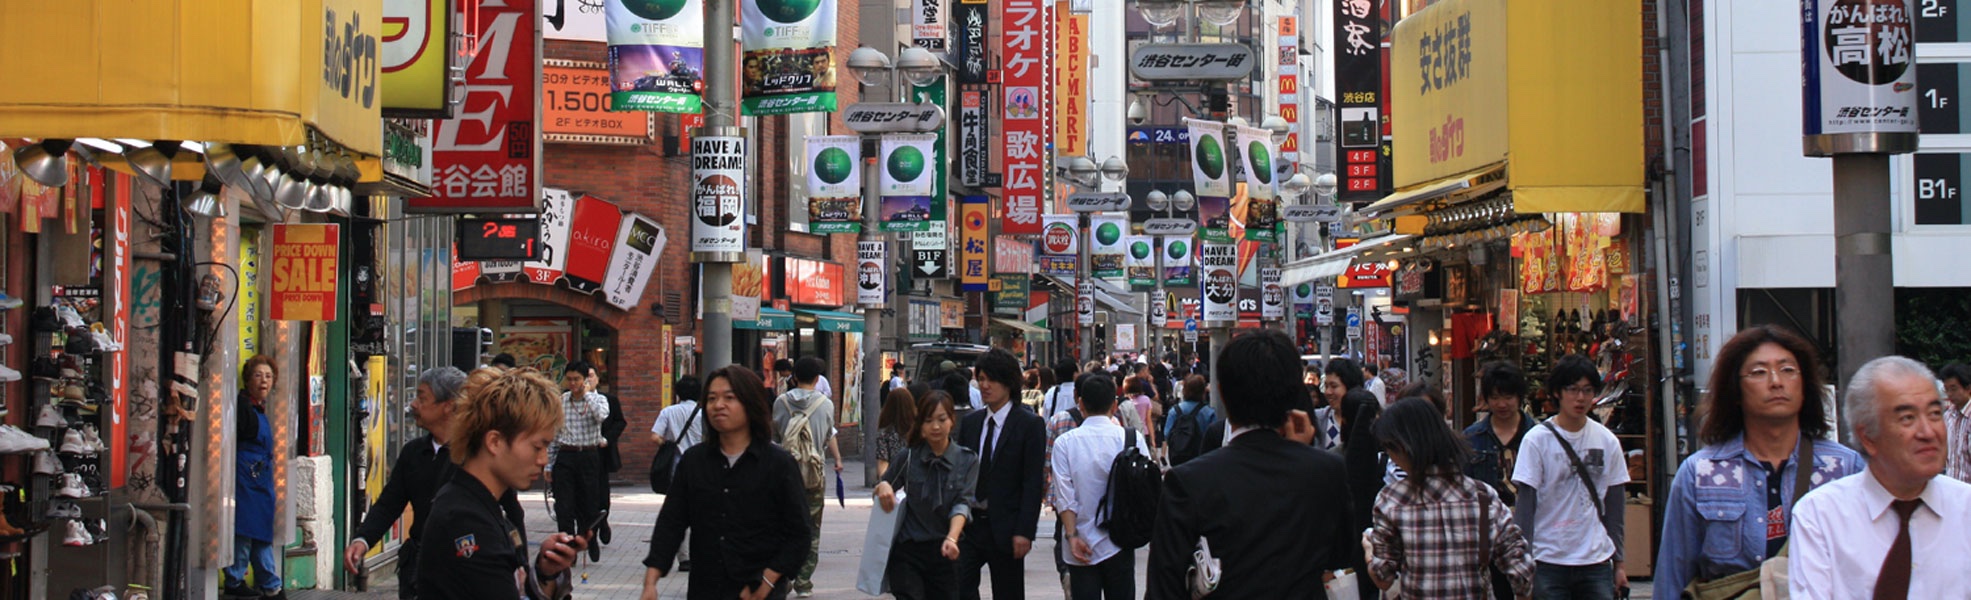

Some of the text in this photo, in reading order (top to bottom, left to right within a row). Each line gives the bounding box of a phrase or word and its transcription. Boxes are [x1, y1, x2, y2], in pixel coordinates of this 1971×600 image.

[1830, 5, 1909, 24] がんばれ!
[1922, 0, 1946, 17] 2F
[1831, 25, 1909, 66] 高松
[1420, 11, 1471, 96] 安さ抜群
[1138, 54, 1247, 68] 渋谷センター街
[1343, 92, 1375, 103] 渋谷店
[1925, 89, 1947, 109] 1F
[848, 110, 935, 122] 渋谷センター街
[1837, 106, 1909, 118] 渋谷センター街
[694, 141, 742, 154] HAVE A
[963, 110, 978, 184] 牛角食堂
[694, 156, 742, 170] DREAM!
[1353, 165, 1370, 175] 3F
[1006, 130, 1038, 224] 歌広場
[1353, 179, 1370, 189] 2F
[1919, 179, 1956, 199] B1F
[697, 196, 738, 217] 福岡
[573, 227, 609, 249] akira
[274, 244, 335, 257] PRICE DOWN
[917, 251, 941, 260] B1F
[966, 237, 985, 277] 松屋
[1205, 247, 1227, 256] HAVE
[273, 257, 335, 292] SALE
[536, 270, 551, 281] 3F
[1207, 284, 1235, 297] 大分
[612, 296, 625, 304] 5F
